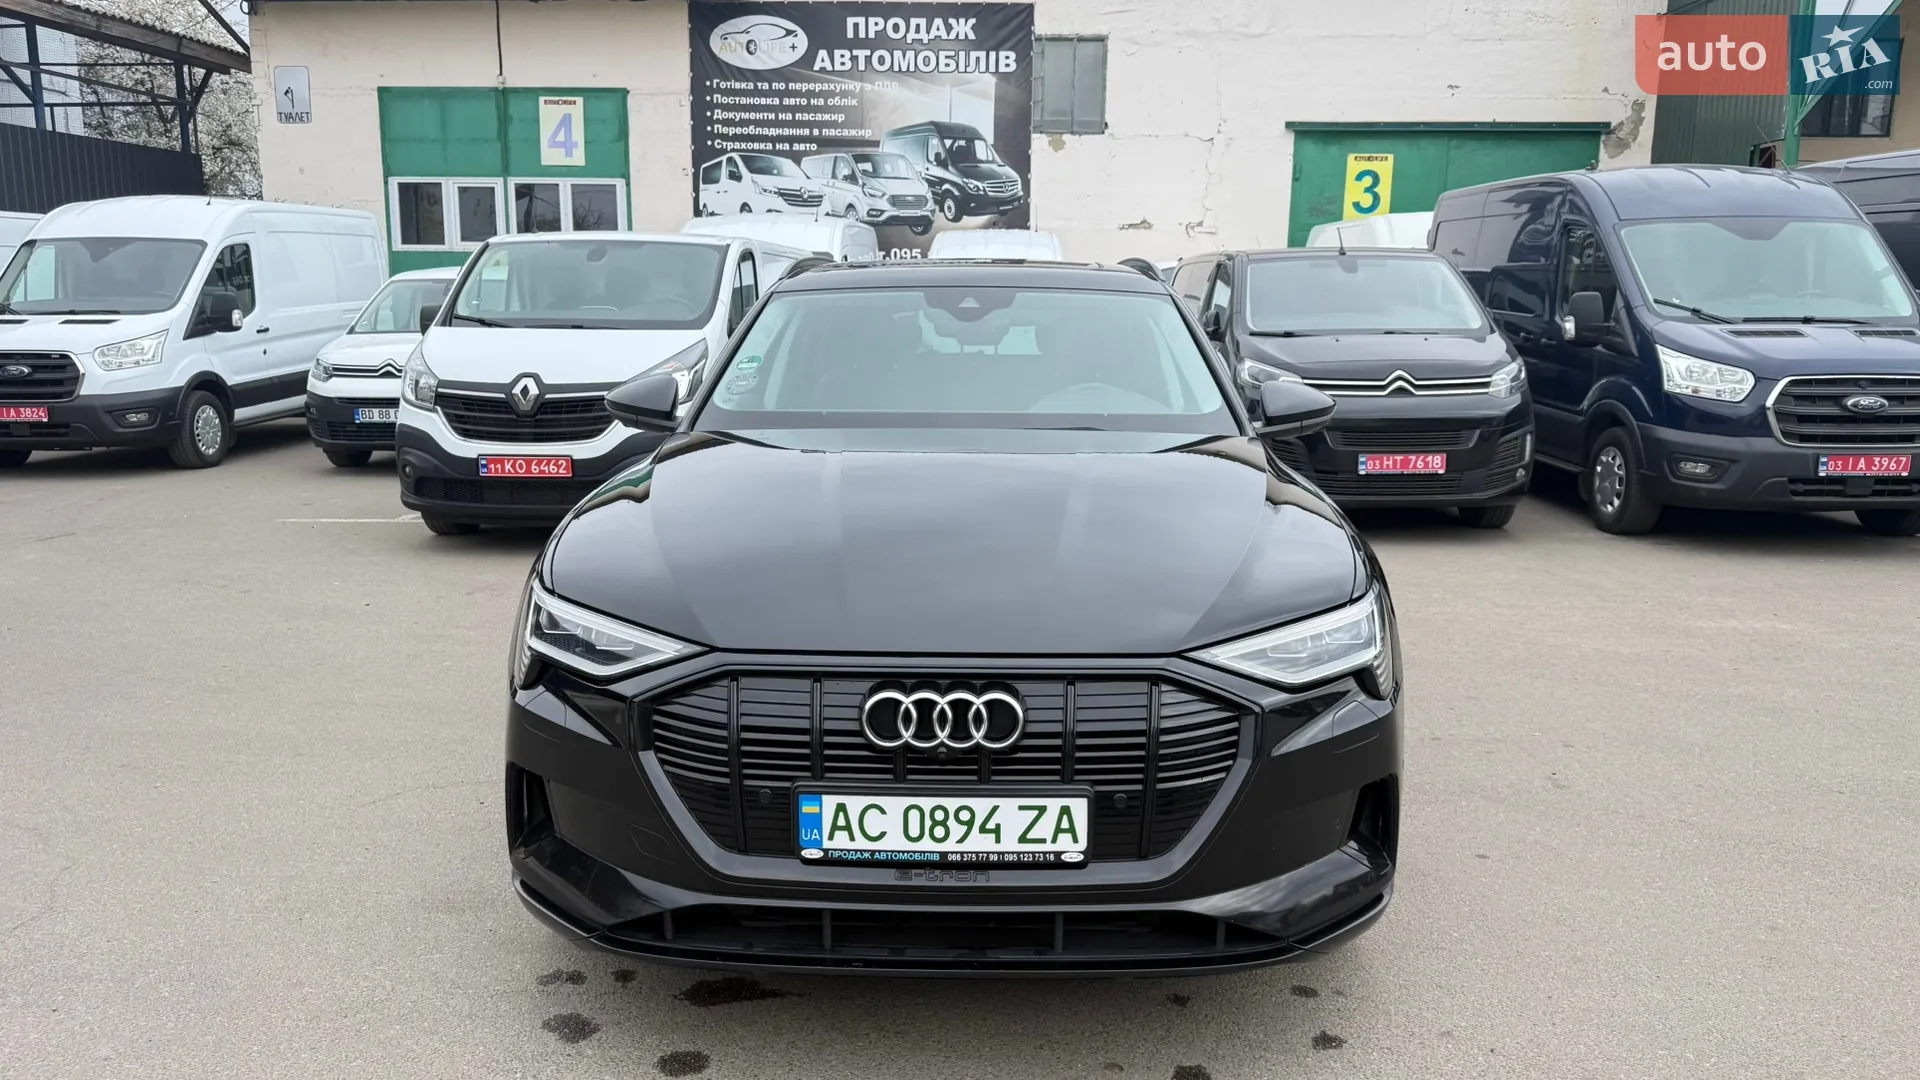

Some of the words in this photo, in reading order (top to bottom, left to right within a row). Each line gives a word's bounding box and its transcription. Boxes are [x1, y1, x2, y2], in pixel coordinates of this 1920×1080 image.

[846, 17, 977, 44] ПРОДАЖ
[813, 49, 1017, 73] АВТОМОБІЛІВ
[713, 79, 754, 90] Готівка
[757, 82, 768, 90] та
[772, 82, 786, 90] по
[788, 82, 861, 92] перерахунку
[713, 94, 779, 105] Постановка
[782, 97, 807, 106] авто
[810, 97, 824, 106] на
[827, 96, 858, 106] облік
[277, 112, 311, 122] ТУАЛЕТ
[713, 109, 775, 121] Документи
[778, 112, 792, 121] на
[795, 112, 845, 123] пасажир
[547, 112, 578, 158] 4
[714, 124, 809, 137] Переобладнання
[813, 128, 819, 136] в
[822, 128, 872, 138] пасажир
[714, 139, 773, 151] Страховка
[776, 142, 790, 150] на
[793, 142, 817, 151] авто
[1352, 169, 1381, 215] 3
[1858, 399, 1881, 409] Ford
[20, 407, 45, 418] 3824
[361, 409, 374, 420] BD
[378, 409, 391, 420] 88
[489, 463, 502, 473] 11
[531, 459, 567, 473] 6462
[1367, 460, 1380, 470] 03
[1383, 456, 1404, 469] HT
[1408, 455, 1442, 469] 7618
[1828, 461, 1842, 470] 03
[1871, 457, 1907, 471] 3967
[827, 802, 888, 842] AC
[902, 803, 1002, 845] 0894
[1017, 804, 1079, 844] ZA
[801, 828, 821, 841] UA
[828, 850, 872, 860] ПРОДАЖ
[873, 852, 940, 861] АВТОМОБІЛІВ
[947, 853, 961, 861] 066
[963, 853, 977, 861] 375
[978, 853, 987, 861] 77
[989, 853, 998, 861] 99
[1004, 853, 1018, 861] 095
[1020, 853, 1033, 861] 123
[1034, 853, 1044, 861] 73
[1045, 853, 1055, 861] 16
[894, 867, 990, 882] e-tron
